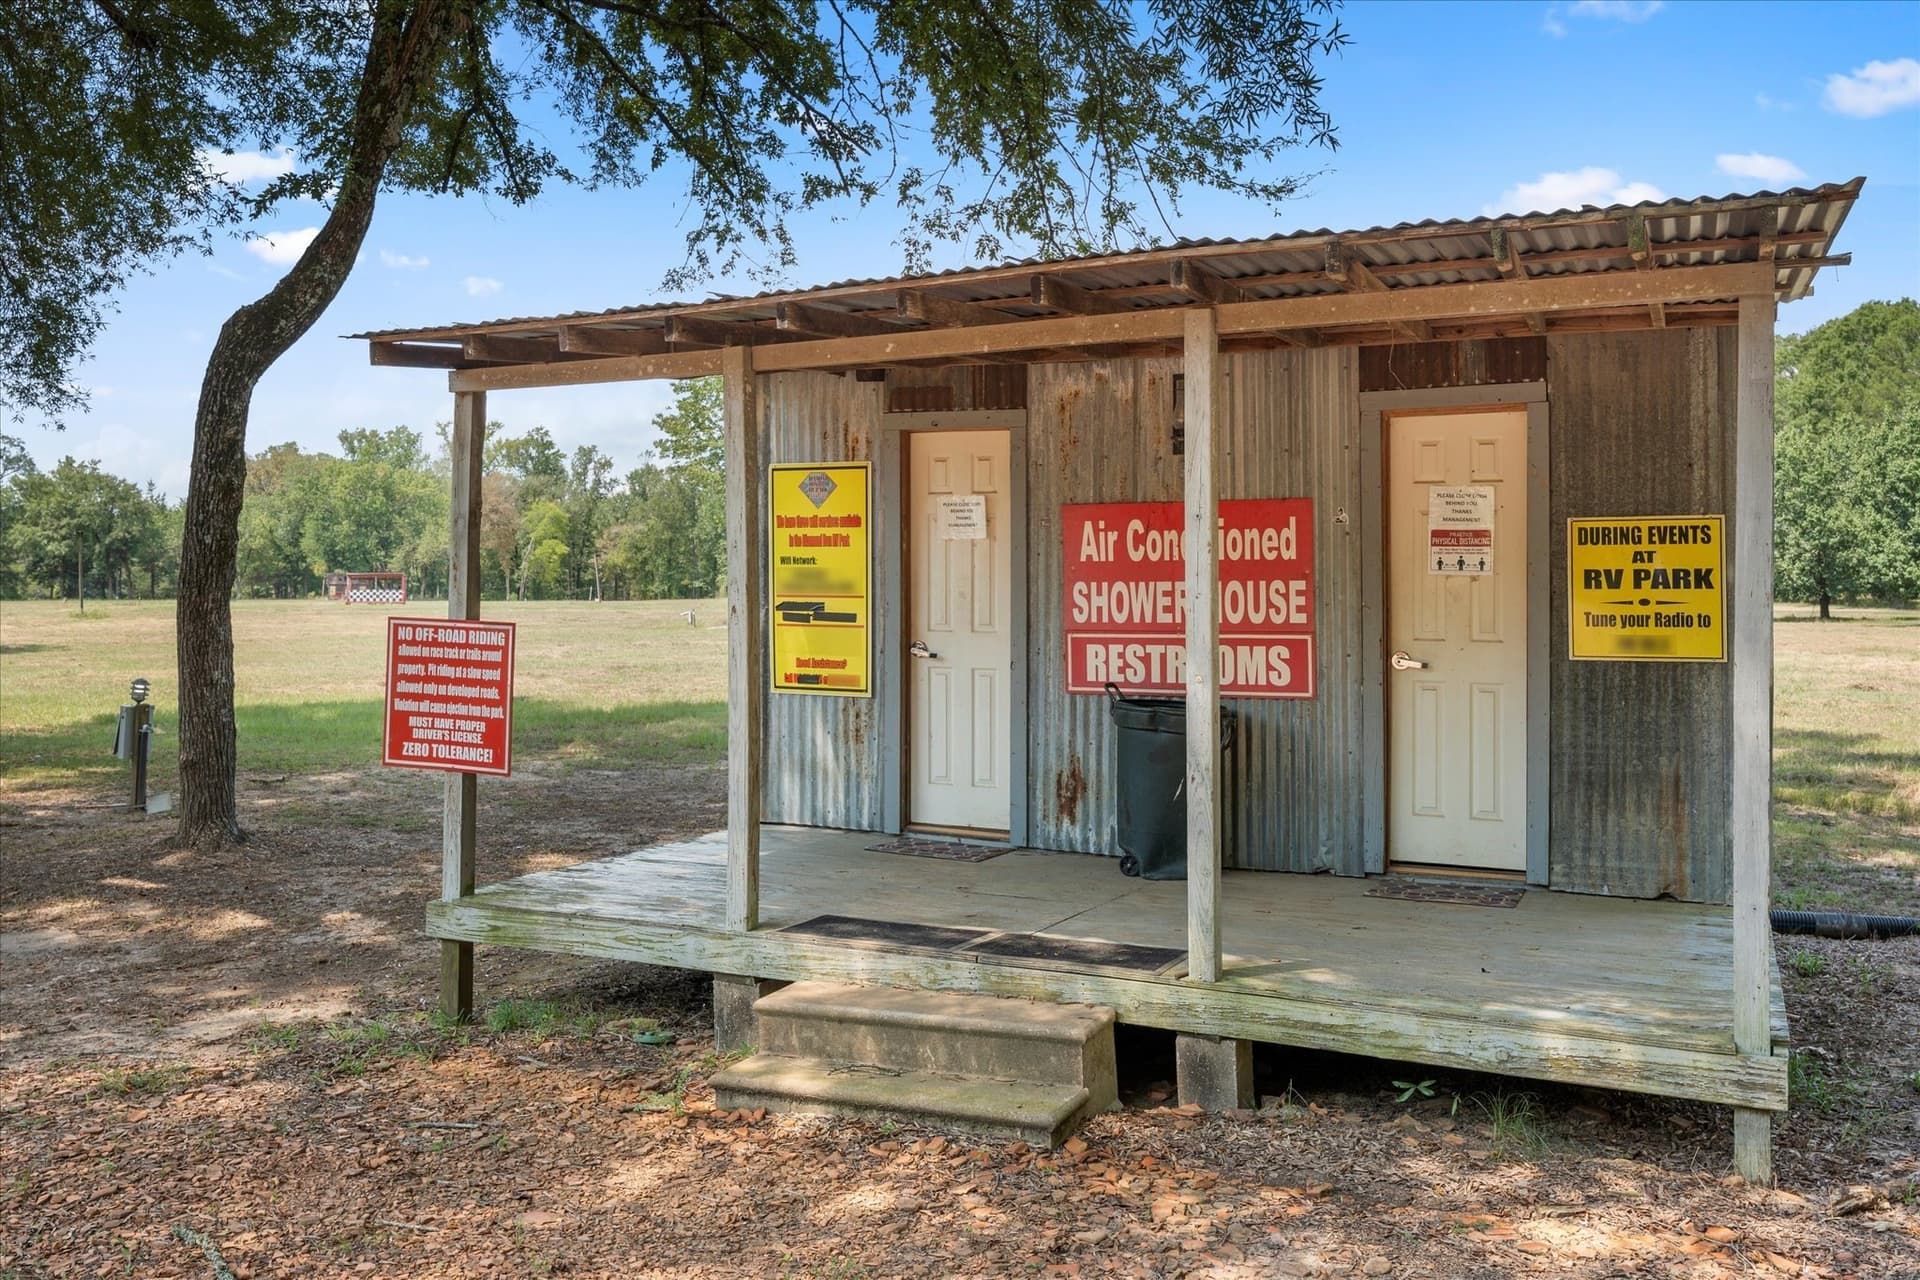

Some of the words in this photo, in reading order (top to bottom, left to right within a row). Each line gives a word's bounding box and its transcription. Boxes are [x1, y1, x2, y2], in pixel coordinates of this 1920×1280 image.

[1080, 520, 1119, 562] Air
[1126, 516, 1297, 562] Conioned
[1577, 526, 1643, 546] DURING
[1647, 525, 1712, 545] EVENTS
[1631, 550, 1657, 564] AT
[1583, 568, 1625, 590] RV
[1632, 568, 1715, 590] PARK
[1218, 580, 1308, 624] OUSE
[1584, 611, 1617, 628] Tune
[1620, 613, 1651, 629] your
[1654, 612, 1694, 628] Radio
[1697, 612, 1712, 628] to
[397, 626, 413, 641] NO
[415, 627, 466, 644] OFF-ROAD
[468, 630, 505, 646] RIDING
[398, 644, 421, 657] allowed
[422, 646, 430, 657] on
[430, 647, 444, 658] race
[444, 646, 459, 659] track
[459, 649, 466, 660] or
[466, 647, 481, 661] trails
[481, 649, 502, 662] around
[397, 663, 426, 676] property.
[437, 664, 455, 678] riding
[455, 665, 462, 678] at
[467, 665, 481, 680] slow
[481, 667, 501, 681] speed
[1086, 643, 1291, 687] RESTROMS
[396, 680, 423, 694] allowed
[423, 682, 437, 696] only
[438, 683, 447, 696] on
[447, 682, 479, 698] developed
[430, 702, 446, 714] cause
[408, 716, 433, 728] MUST
[434, 718, 455, 730] HAVE
[455, 720, 486, 733] PROPER
[412, 728, 450, 741] DRIVER'S
[402, 741, 429, 757] ZERO
[431, 743, 493, 763] TOLERANCE!
